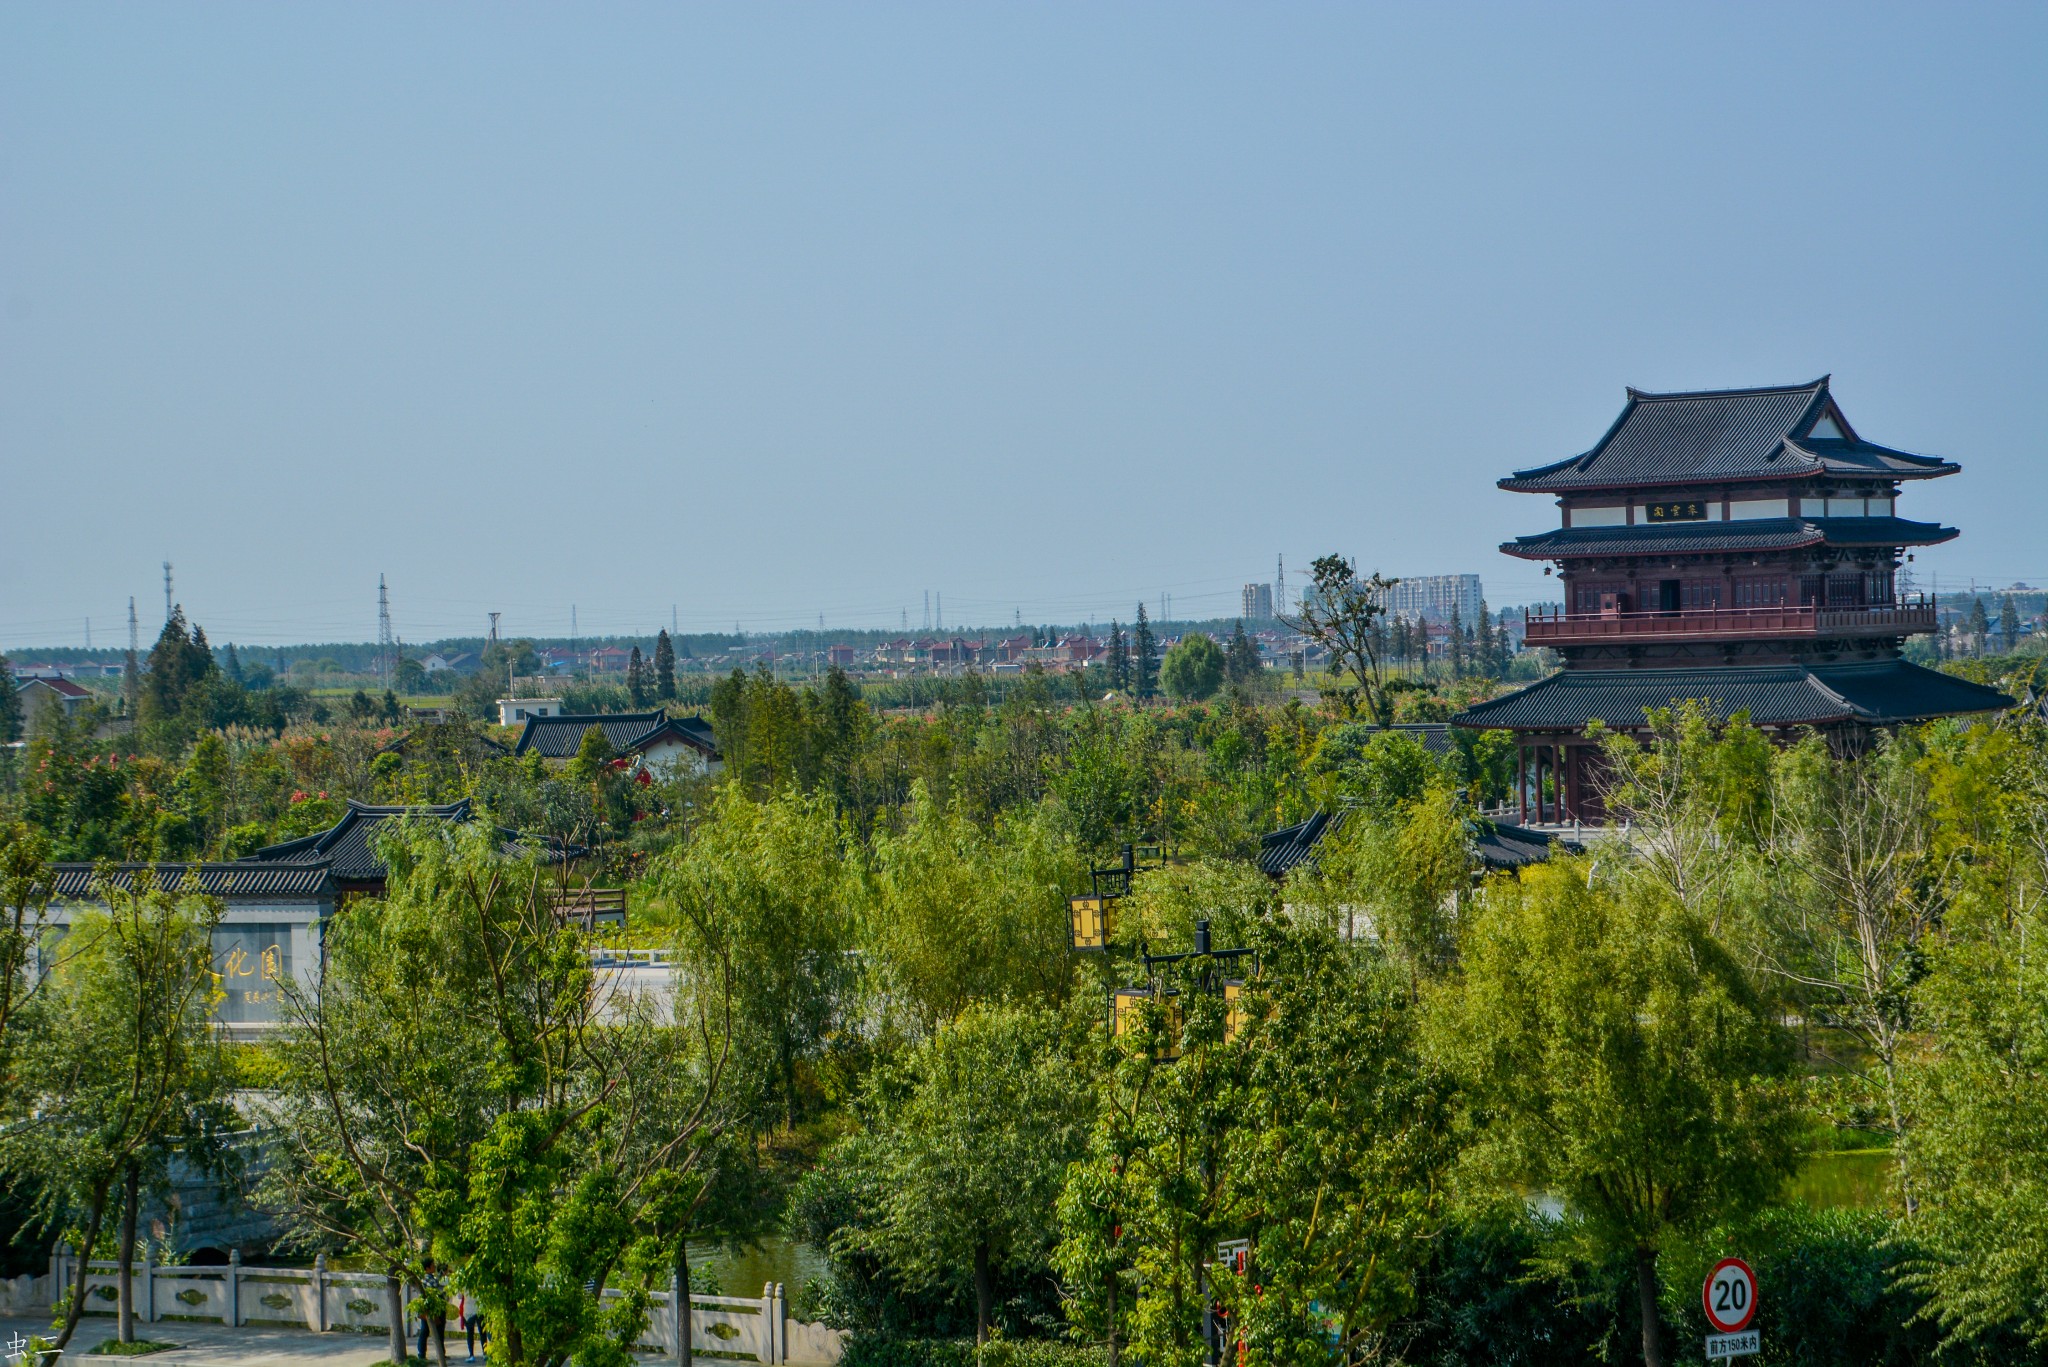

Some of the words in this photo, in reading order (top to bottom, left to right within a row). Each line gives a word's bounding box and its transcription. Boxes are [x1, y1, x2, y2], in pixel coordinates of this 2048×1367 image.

[1715, 1279, 1746, 1311] 20
[1709, 1334, 1757, 1356] 前方150米内
